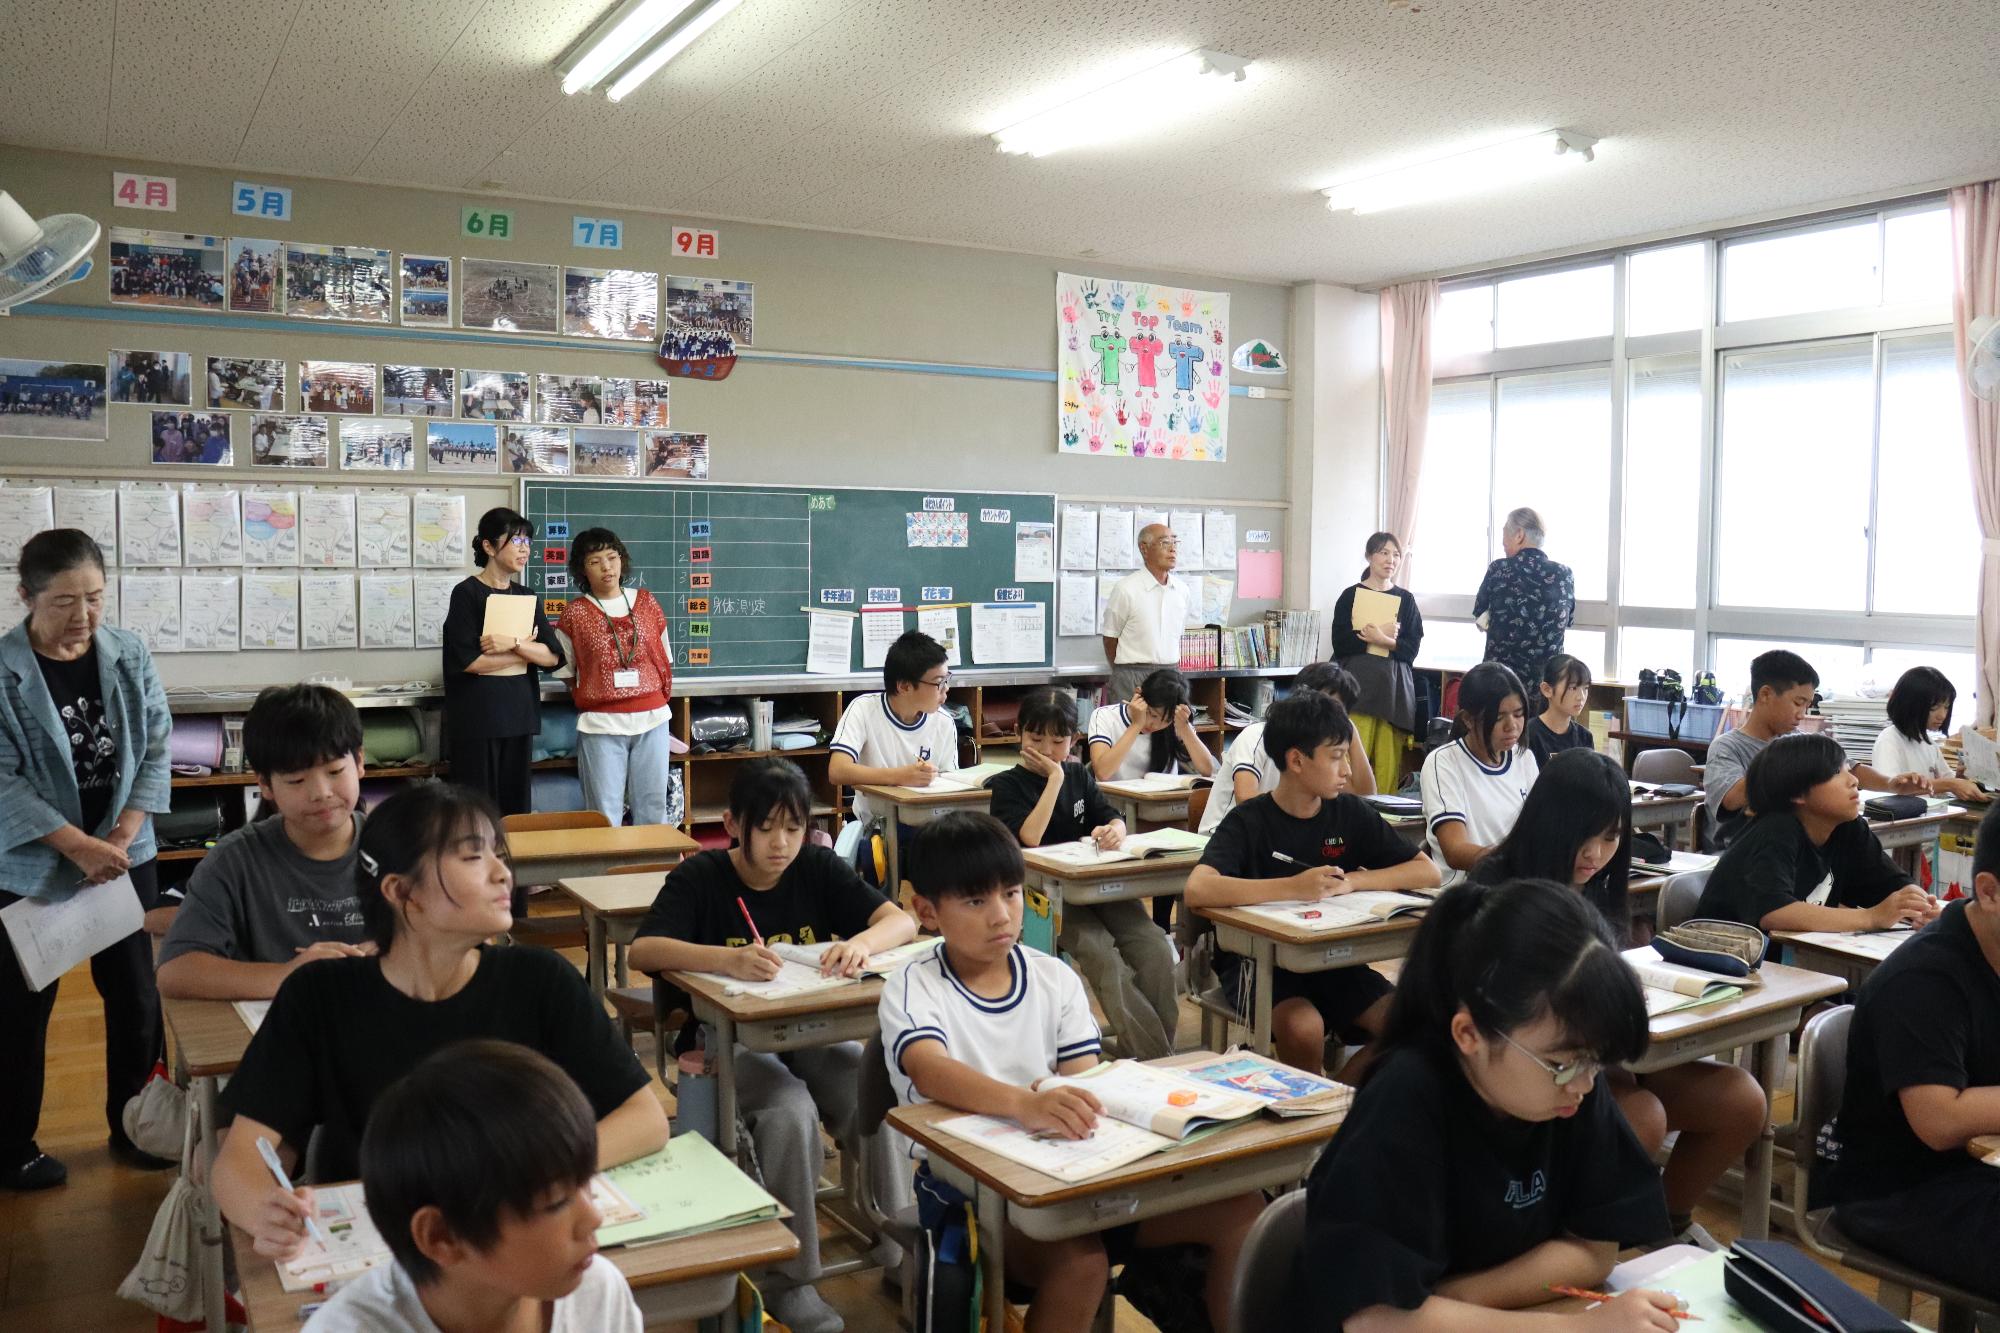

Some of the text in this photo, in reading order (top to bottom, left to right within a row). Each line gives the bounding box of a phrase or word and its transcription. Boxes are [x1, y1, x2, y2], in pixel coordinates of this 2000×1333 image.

[118, 179, 169, 207] 4月
[237, 188, 284, 217] 5月
[466, 212, 509, 238] 6月
[578, 222, 618, 247] 7月
[676, 231, 715, 256] 9月
[1096, 309, 1204, 335] Try Top Team
[810, 496, 833, 510] めあて
[547, 525, 567, 535] 算数
[691, 525, 709, 535] 算数
[533, 550, 541, 559] 2
[545, 550, 566, 560] 英語
[678, 553, 689, 563] 2
[692, 550, 710, 560] 国語
[547, 575, 567, 586] 家庭
[679, 571, 688, 584] 3
[692, 576, 710, 586] 図工
[546, 602, 566, 613] 社会
[677, 594, 688, 611] 4
[689, 601, 708, 611] 総合
[713, 596, 767, 616] 身体測定
[678, 621, 688, 639] 5
[691, 624, 709, 634] 理科
[677, 645, 688, 665] 6
